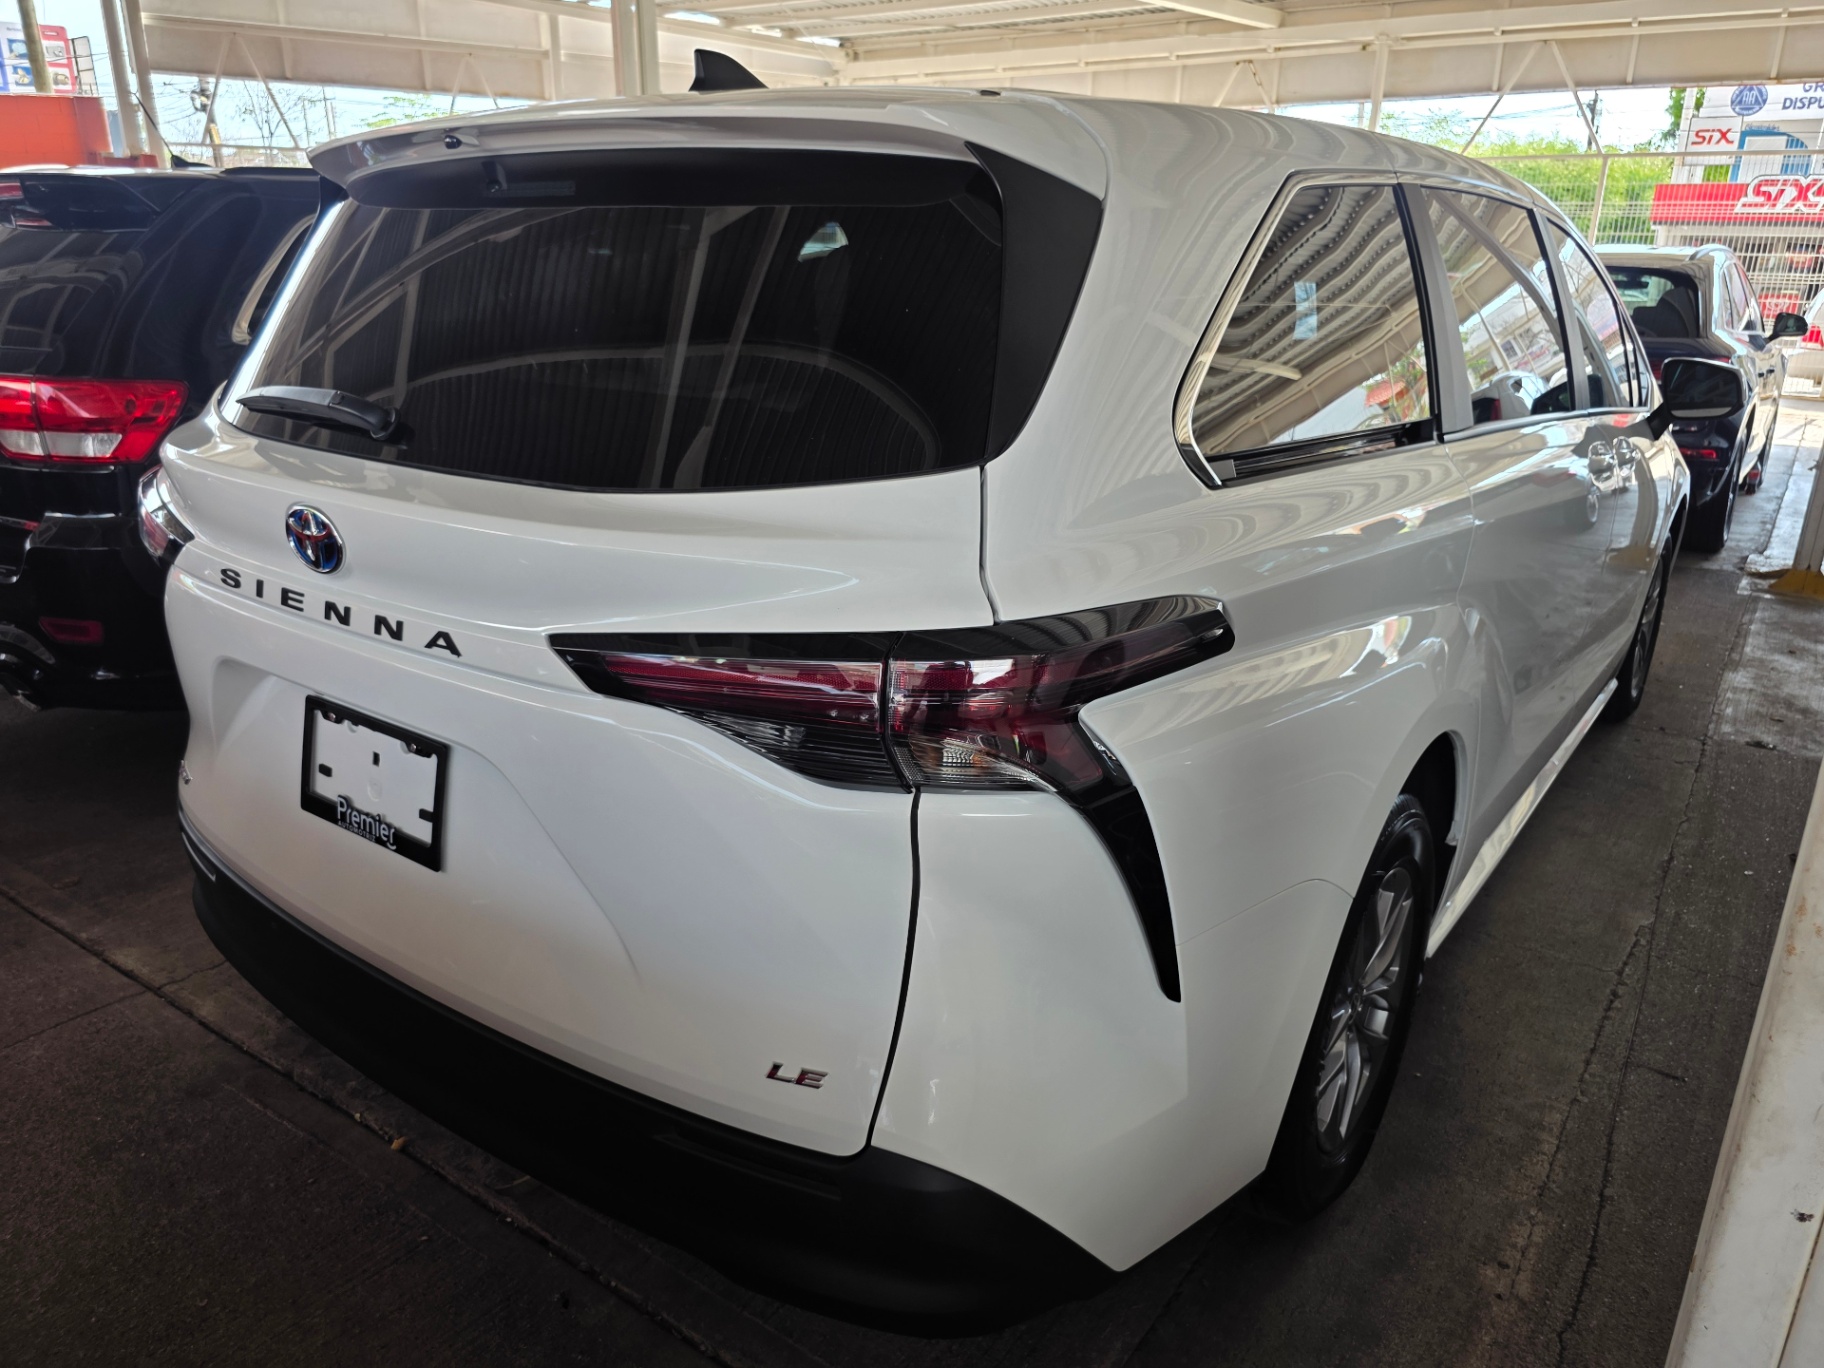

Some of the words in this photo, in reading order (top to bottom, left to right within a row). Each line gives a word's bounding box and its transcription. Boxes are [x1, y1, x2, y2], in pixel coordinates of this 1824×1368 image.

[220, 568, 463, 658] SIENNA
[337, 796, 396, 846] Premier
[765, 1061, 828, 1090] LE
